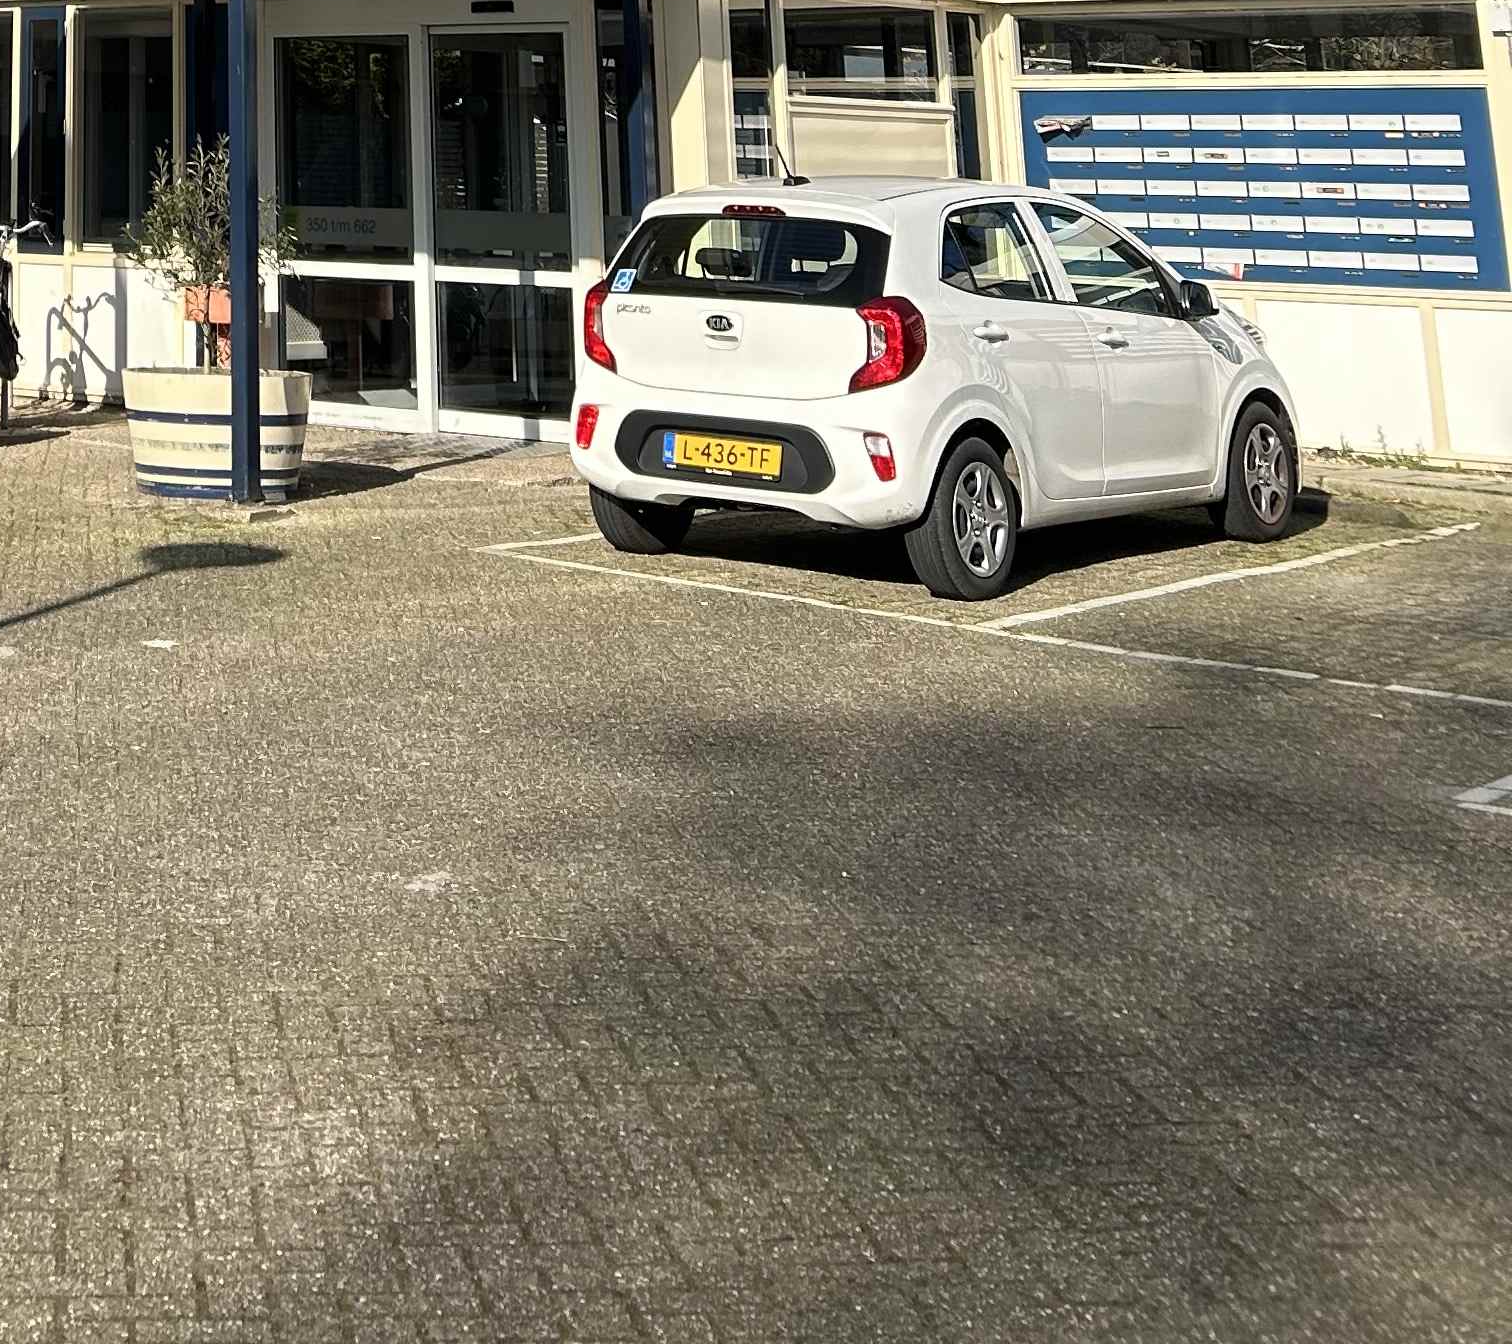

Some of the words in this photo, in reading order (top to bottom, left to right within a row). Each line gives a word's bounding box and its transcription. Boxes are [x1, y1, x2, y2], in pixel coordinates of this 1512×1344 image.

[306, 217, 328, 232] 350
[353, 219, 377, 234] 662
[708, 317, 731, 330] KIA
[683, 439, 771, 469] L-436-TF
